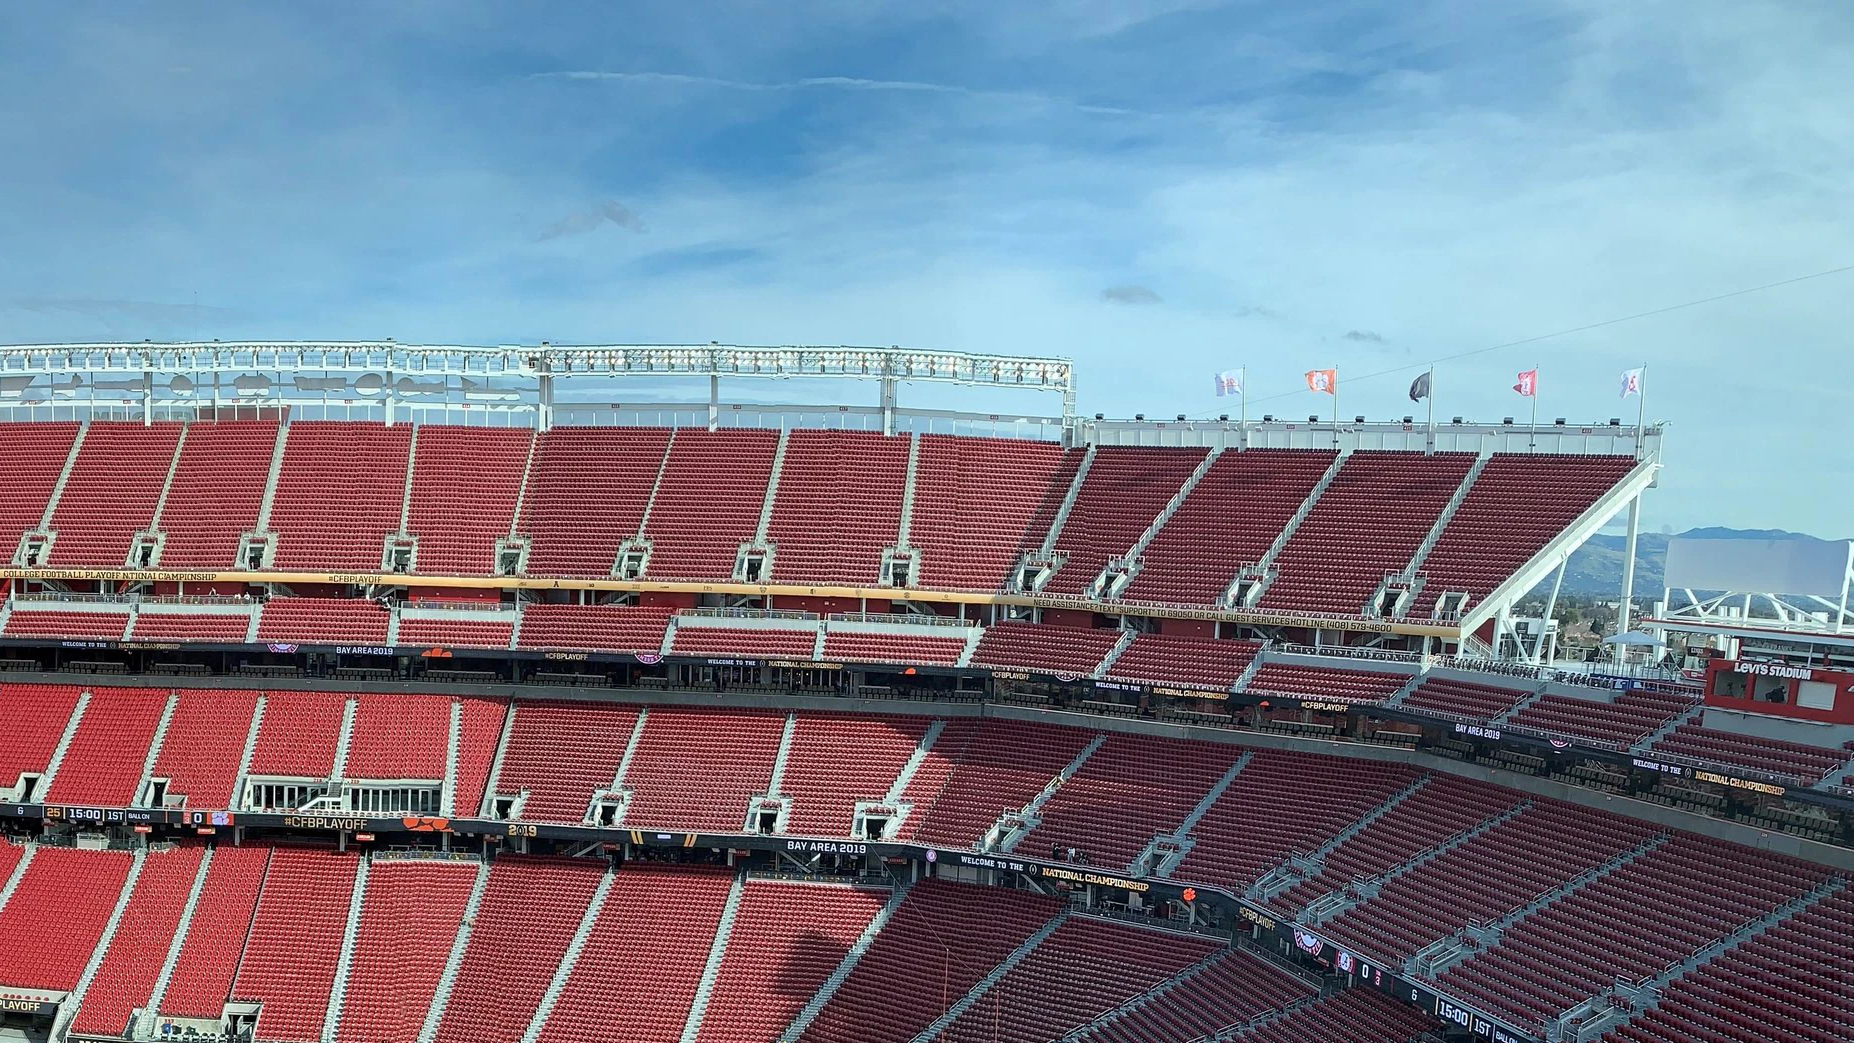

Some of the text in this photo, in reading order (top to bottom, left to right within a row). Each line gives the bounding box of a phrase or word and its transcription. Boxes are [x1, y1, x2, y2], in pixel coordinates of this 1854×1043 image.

[3, 570, 40, 578] COLLEGE
[85, 571, 120, 579] PLAYOFF
[328, 575, 382, 583] #CFBPLAYOFF
[1033, 599, 1051, 607] NEED
[1099, 604, 1116, 612] TEXT
[1167, 610, 1192, 618] 69050
[1206, 612, 1224, 620] CALL
[1226, 614, 1251, 622] GUEST
[1252, 615, 1290, 625] SERVICES
[1291, 618, 1324, 627] HOTLINE
[1326, 620, 1349, 630] (408)
[336, 646, 393, 656] BAY AREA 2019
[768, 660, 799, 668] NATIONAL
[992, 671, 1030, 680] #CFBPLAYOFF
[1769, 665, 1812, 680] STADIUM
[1096, 681, 1120, 690] WELCOME
[1153, 687, 1183, 697] NATIONAL
[1183, 689, 1229, 700] CHAMPIONSHIP
[1301, 701, 1349, 712] #CFBPLAYOFF
[1456, 723, 1501, 740] BAY AREA 2019
[1633, 758, 1786, 796] WELCOME TO THE NATIONAL CHAMPIONSHIP
[46, 808, 124, 821] 25 15:00 1ST
[193, 813, 202, 823] 0
[284, 816, 368, 831] #CFBPLAYOFF
[508, 824, 537, 837] 2019
[787, 840, 867, 854] BAY AREA 2019
[961, 855, 1150, 891] WELCOME TO THE NATIONAL CHAMPIONSHIP
[1239, 905, 1276, 931] #CFBPLAYOFF
[1362, 964, 1369, 979] 0
[1439, 1001, 1491, 1037] 15:00 1ST
